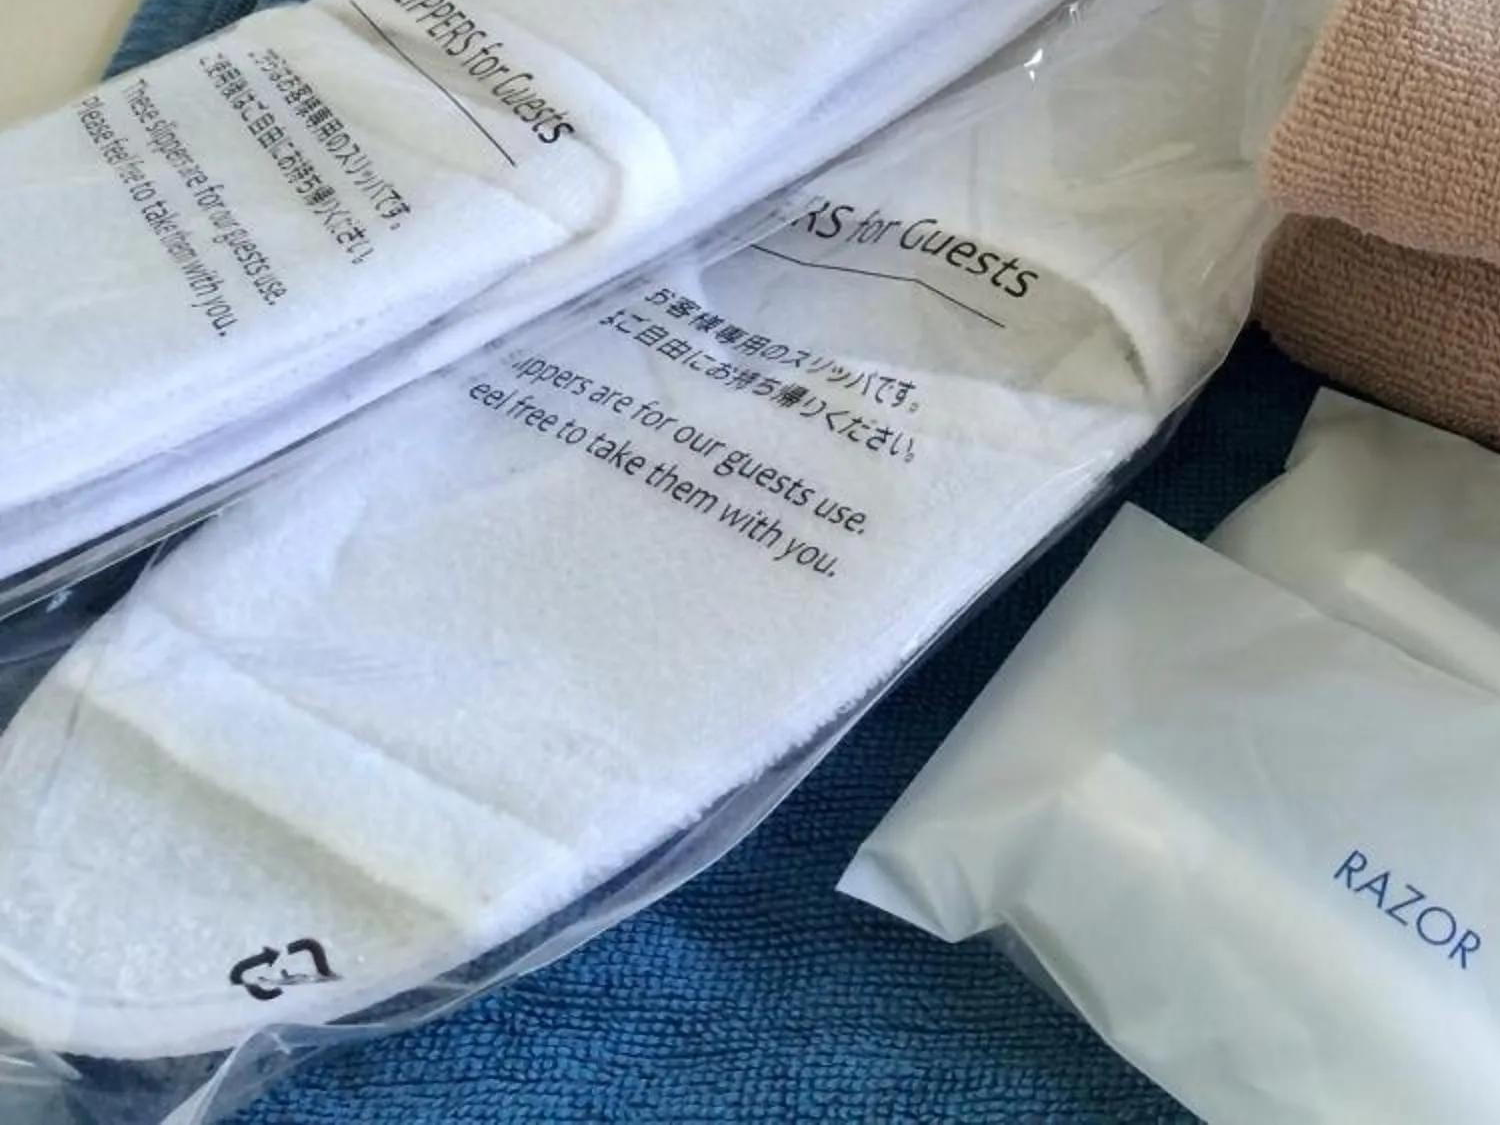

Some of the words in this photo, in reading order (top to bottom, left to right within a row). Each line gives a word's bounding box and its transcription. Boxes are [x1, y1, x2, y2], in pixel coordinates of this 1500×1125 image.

[77, 95, 115, 145] Please
[460, 41, 511, 82] for
[491, 73, 576, 144] Guests
[122, 78, 160, 124] These
[146, 119, 195, 169] slippers
[194, 183, 225, 211] for
[212, 228, 271, 276] guests
[253, 274, 288, 306] use.
[129, 180, 157, 202] to
[141, 200, 181, 236] take
[181, 259, 225, 297] with
[845, 210, 902, 244] for
[898, 218, 1039, 299] Guests
[191, 294, 240, 337] you.
[644, 287, 920, 414] お客様専用のスリッパです。
[468, 381, 519, 411] eel
[505, 394, 560, 433] free
[556, 418, 588, 445] to
[585, 432, 647, 476] take
[644, 461, 721, 515] them
[717, 502, 784, 549] with
[771, 536, 840, 578] you.
[588, 384, 634, 414] are
[630, 399, 679, 431] for
[672, 425, 727, 457] our
[711, 449, 817, 507] guests
[812, 497, 868, 535] use.
[1333, 849, 1482, 970] RAZOR
